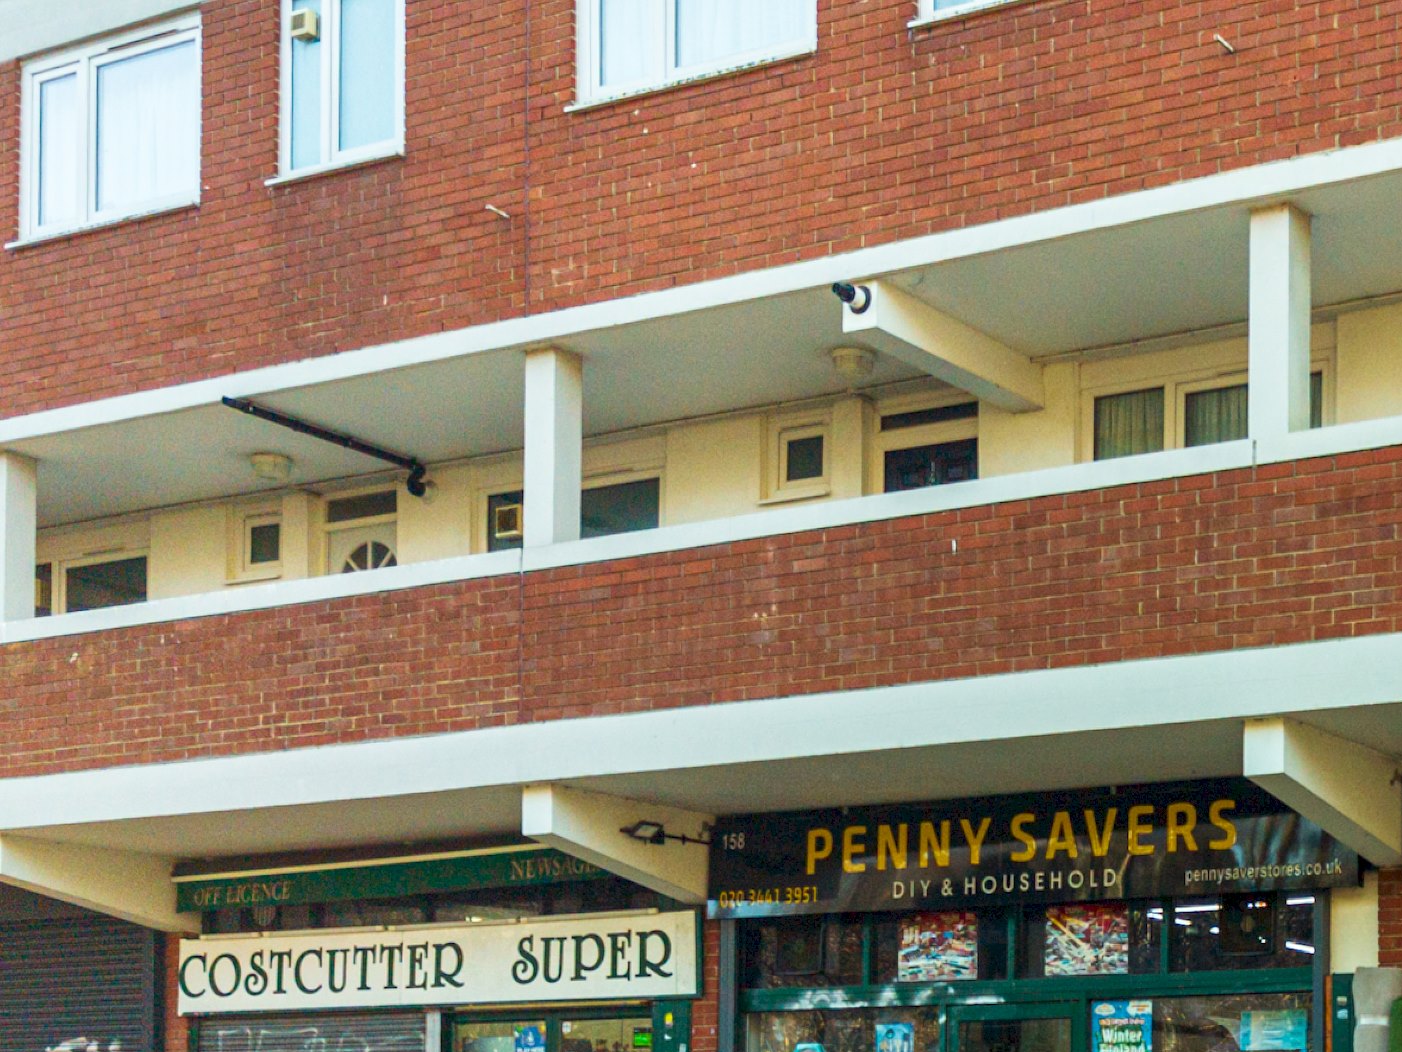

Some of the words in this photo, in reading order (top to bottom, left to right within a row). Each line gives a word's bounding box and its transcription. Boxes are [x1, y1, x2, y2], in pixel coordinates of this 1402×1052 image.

[722, 832, 746, 850] 158
[805, 817, 992, 876] PENNY
[1009, 799, 1237, 863] SAVERS
[892, 881, 932, 900] DIY
[941, 880, 953, 896] &
[963, 867, 1117, 896] HOUSEHOLD
[1184, 857, 1343, 887] pennysaverstores.co.uk
[719, 890, 745, 908] 020
[749, 888, 781, 906] 3441
[784, 886, 818, 904] 3951
[178, 940, 466, 998] COSTCUTTER
[511, 929, 673, 984] SUPER
[1102, 1026, 1142, 1044] Winter
